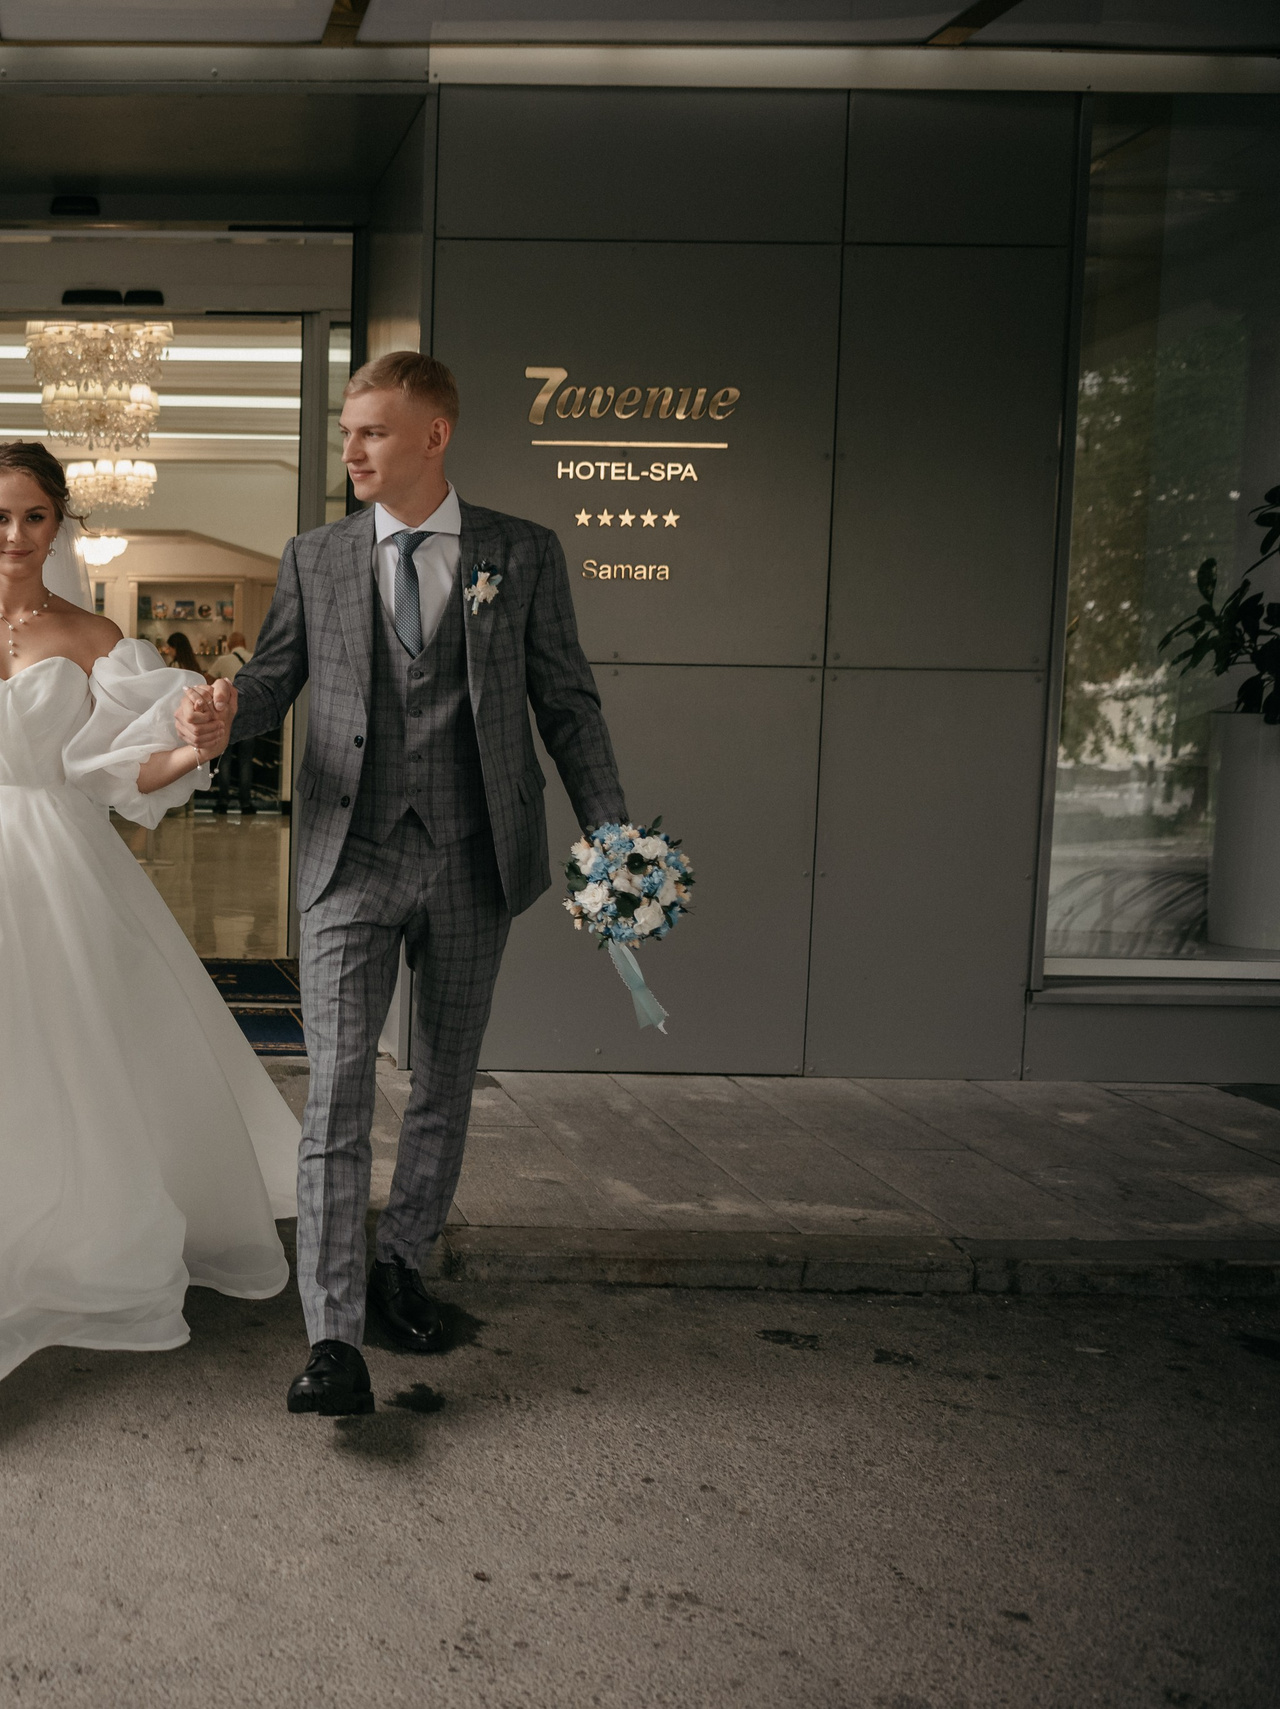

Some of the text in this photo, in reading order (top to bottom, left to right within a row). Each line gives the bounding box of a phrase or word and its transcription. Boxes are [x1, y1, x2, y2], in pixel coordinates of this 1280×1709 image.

[525, 366, 741, 426] 7avenue
[556, 460, 699, 482] HOTEL-SPA
[581, 559, 670, 581] Samara
